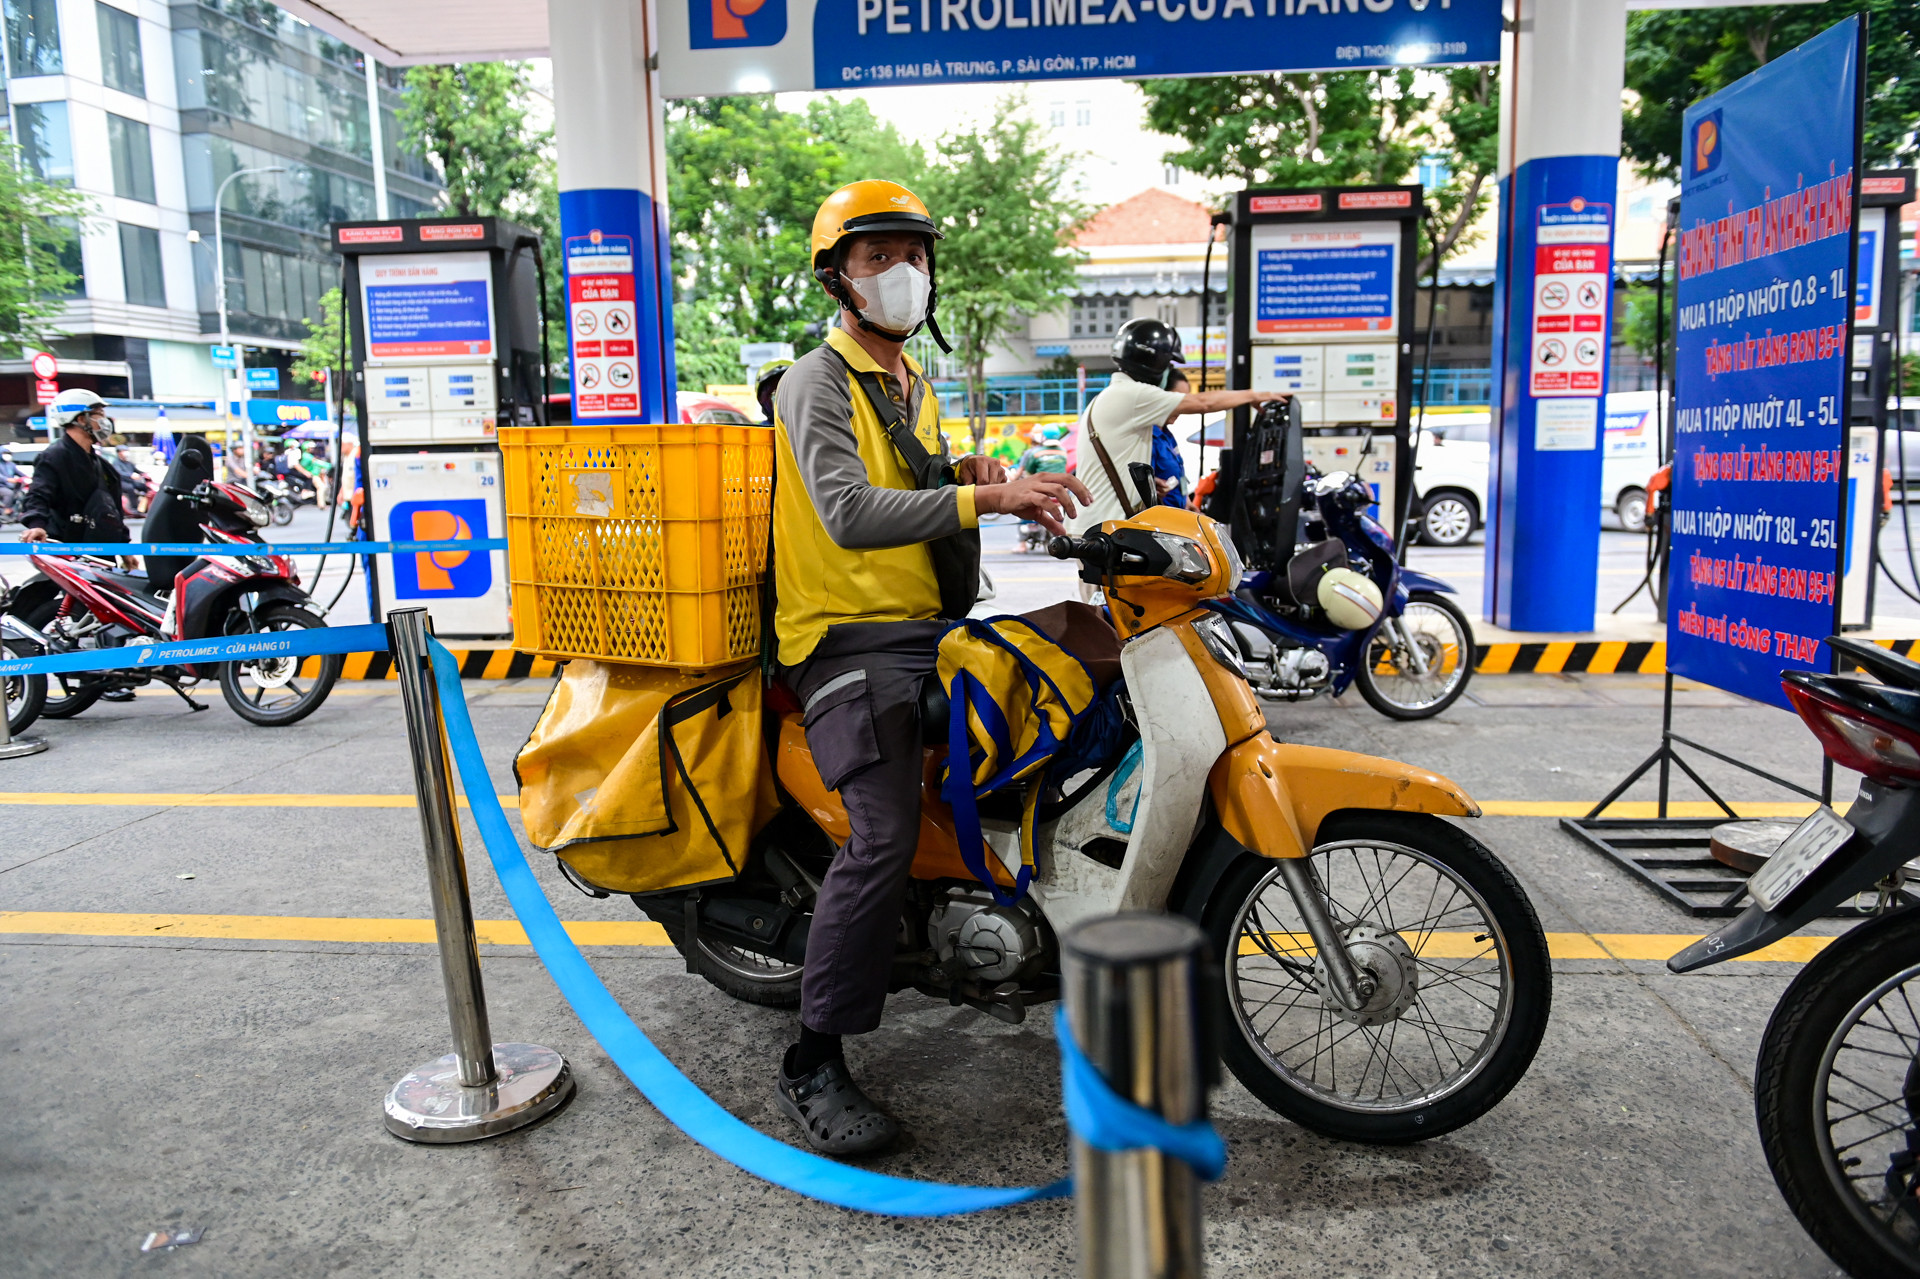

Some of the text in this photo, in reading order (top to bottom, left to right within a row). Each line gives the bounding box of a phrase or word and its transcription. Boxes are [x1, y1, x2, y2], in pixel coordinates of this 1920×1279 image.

[895, 63, 919, 78] HAI
[922, 60, 943, 77] BÀ
[1017, 55, 1040, 73] SÀI
[1104, 55, 1137, 70] HCM
[1336, 44, 1361, 61] ĐIỆN
[1680, 218, 1716, 280] CHƯƠNG
[1717, 200, 1746, 270] TRÌNH
[1780, 172, 1818, 252] KHÁCH
[1818, 159, 1853, 240] HÀNG
[1679, 302, 1706, 332] MUA
[1709, 300, 1715, 325] 1
[1717, 289, 1745, 328] HỘP
[1747, 277, 1789, 318] NHỚT
[1791, 275, 1817, 309] 0.8
[1830, 268, 1847, 300] 1L
[1706, 322, 1848, 381] TẶNG 1 LÍT XĂNG RON 95-V
[1676, 408, 1702, 433] MUA
[1704, 407, 1710, 432] 1
[1712, 398, 1740, 438] HỘP
[1742, 394, 1784, 430] NHỚT
[1786, 399, 1805, 427] 4L
[1818, 396, 1838, 426] 5L
[1374, 461, 1389, 472] 22
[1694, 443, 1842, 487] TẶNG 03 LÍT XĂNG RON 95-V
[1854, 453, 1870, 464] 24
[376, 478, 388, 488] 19
[481, 476, 494, 486] 20
[1672, 509, 1696, 536] MUA
[1698, 511, 1703, 536] 1
[1704, 506, 1732, 544] HỘP
[1733, 508, 1773, 543] NHỚT
[1775, 516, 1798, 545] 18L
[1810, 518, 1837, 549] 25L
[1690, 548, 1836, 605] TẶNG 05 LÍT XĂNG RON 95-V
[1678, 602, 1819, 664] MIỄN PHÍ CÔNG THAY
[159, 646, 219, 659] PETROLIMEX
[226, 641, 246, 654] CỬA
[248, 641, 277, 652] HÀNG
[279, 641, 291, 650] 01
[21, 663, 33, 671] 01
